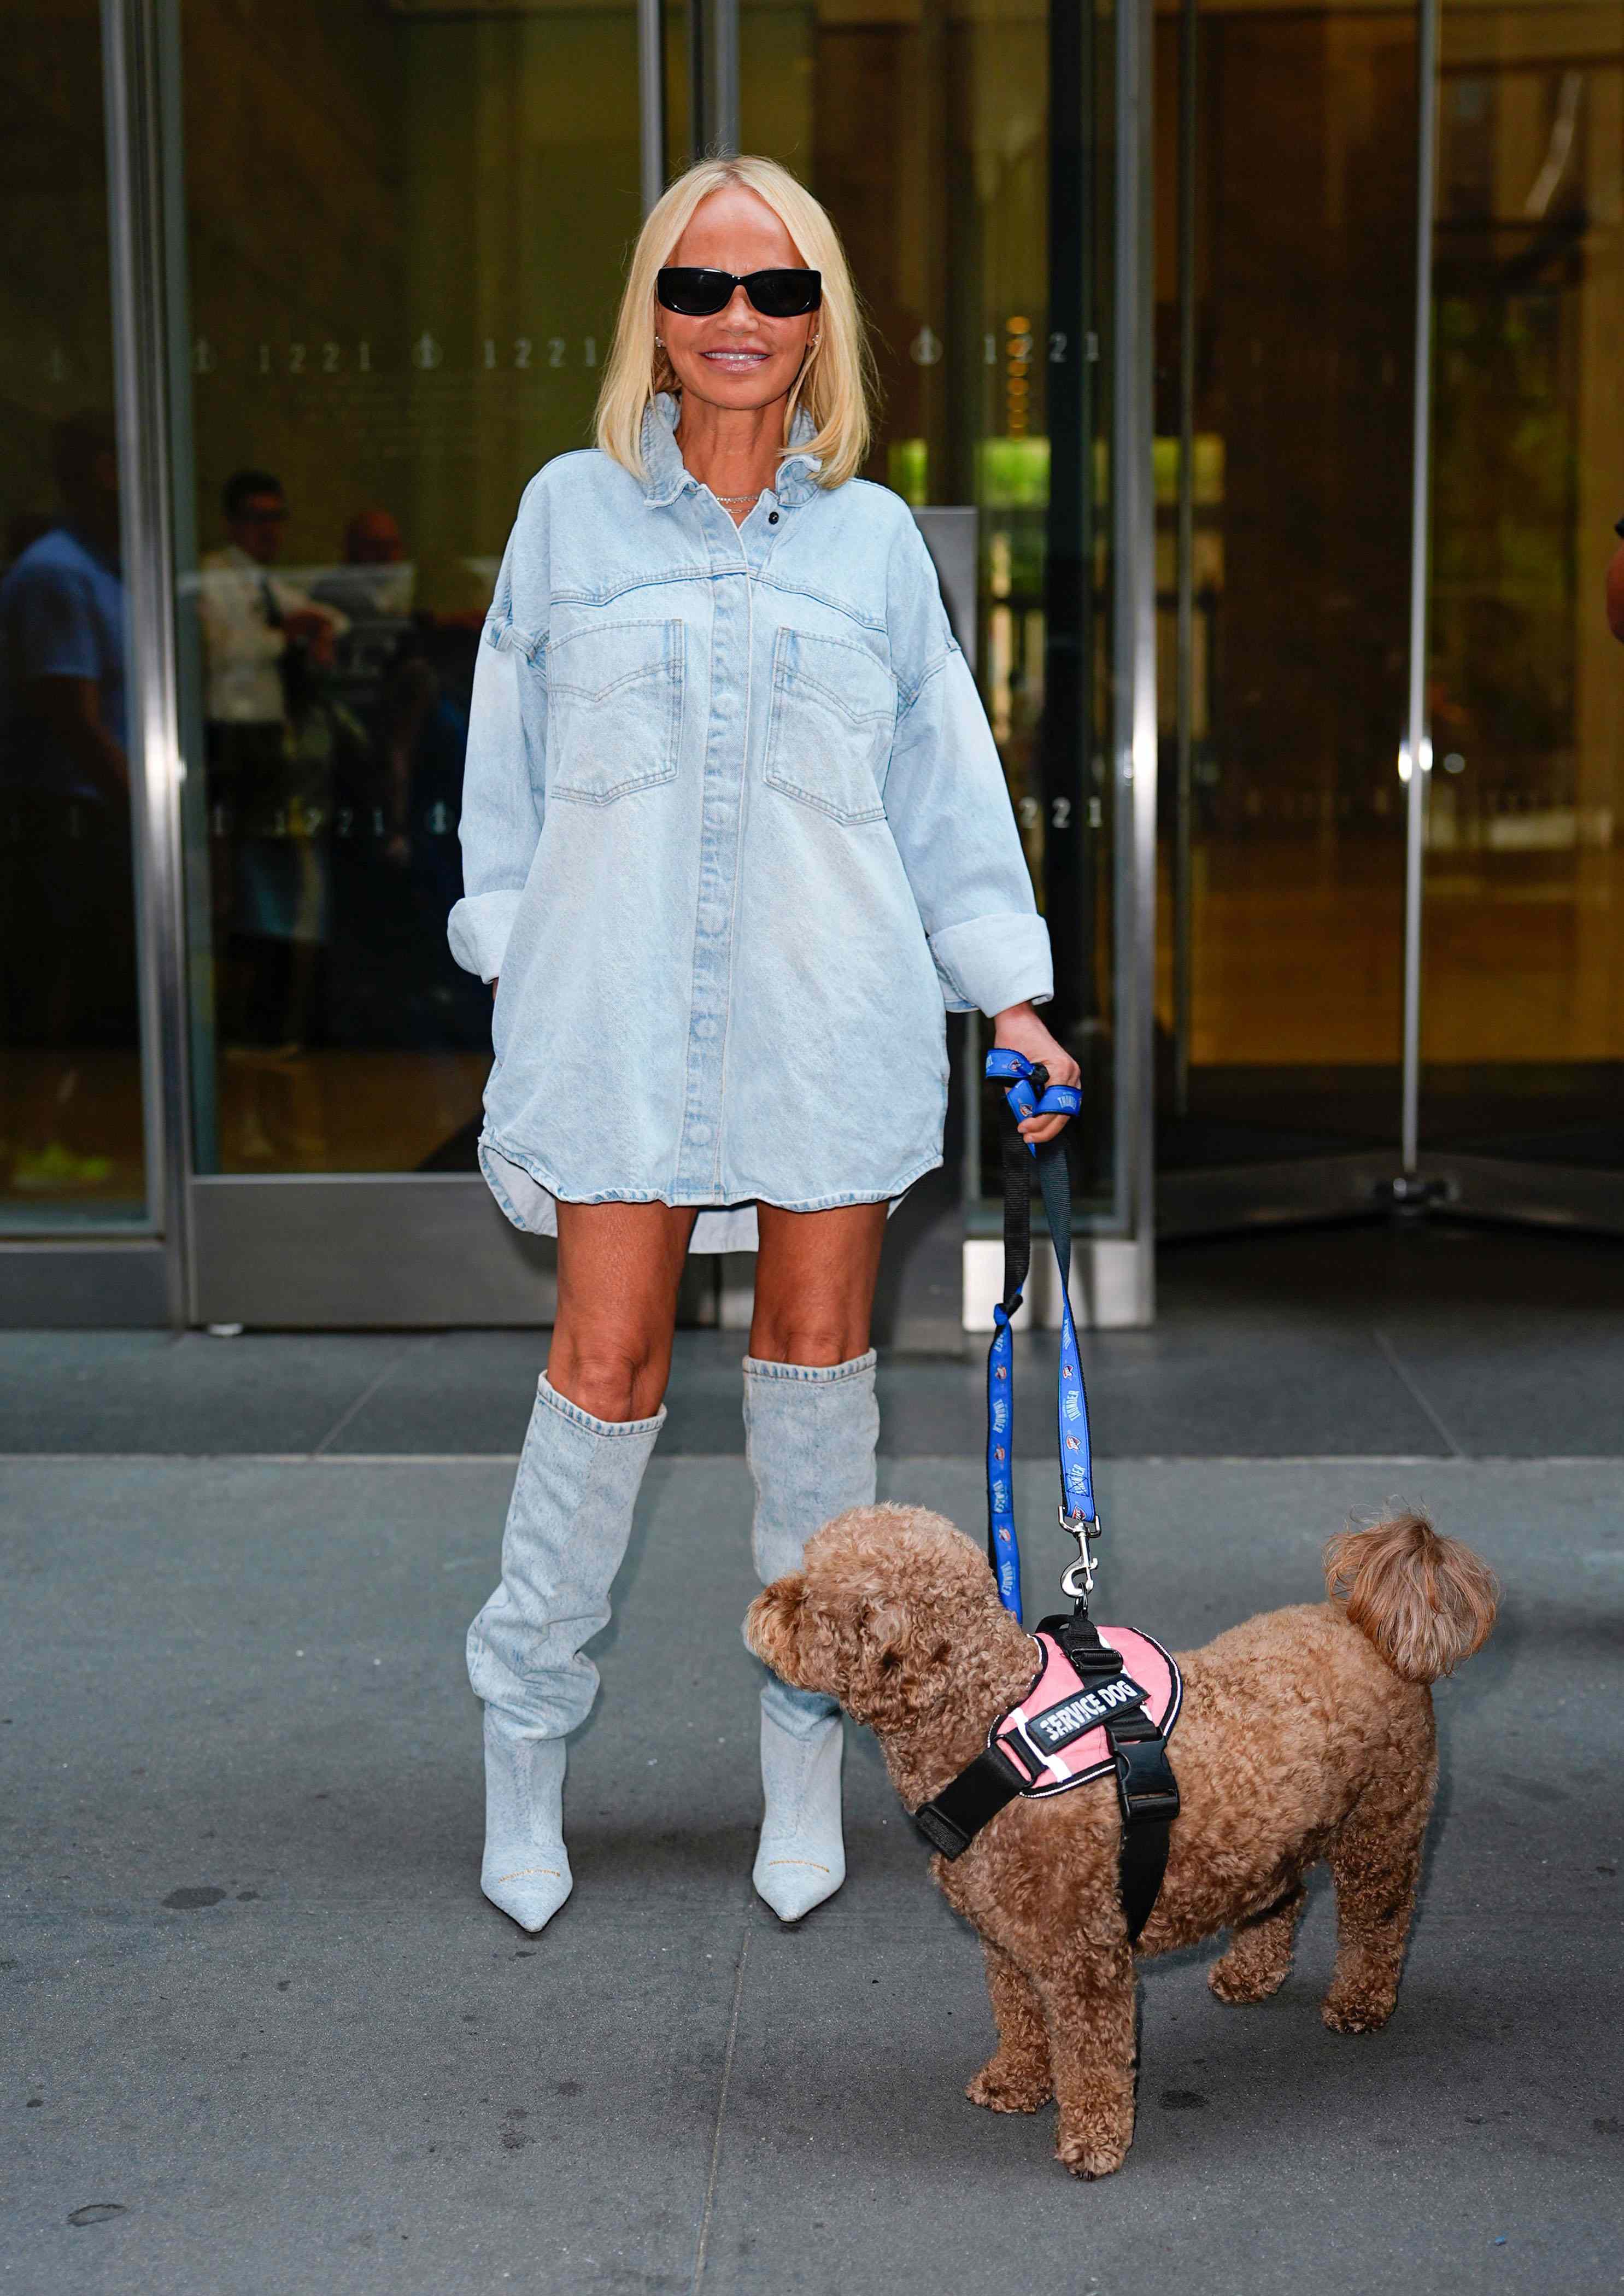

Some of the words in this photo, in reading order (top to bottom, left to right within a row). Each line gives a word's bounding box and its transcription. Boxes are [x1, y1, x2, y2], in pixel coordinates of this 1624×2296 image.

[483, 337, 597, 370] 1221
[1018, 796, 1102, 829] 221
[993, 1399, 1005, 1433] THUNDER
[1065, 1390, 1082, 1421] THUNDER
[1000, 1561, 1013, 1596] THUNDER
[1040, 1693, 1106, 1742] SERVICE
[1098, 1680, 1138, 1708] DOG
